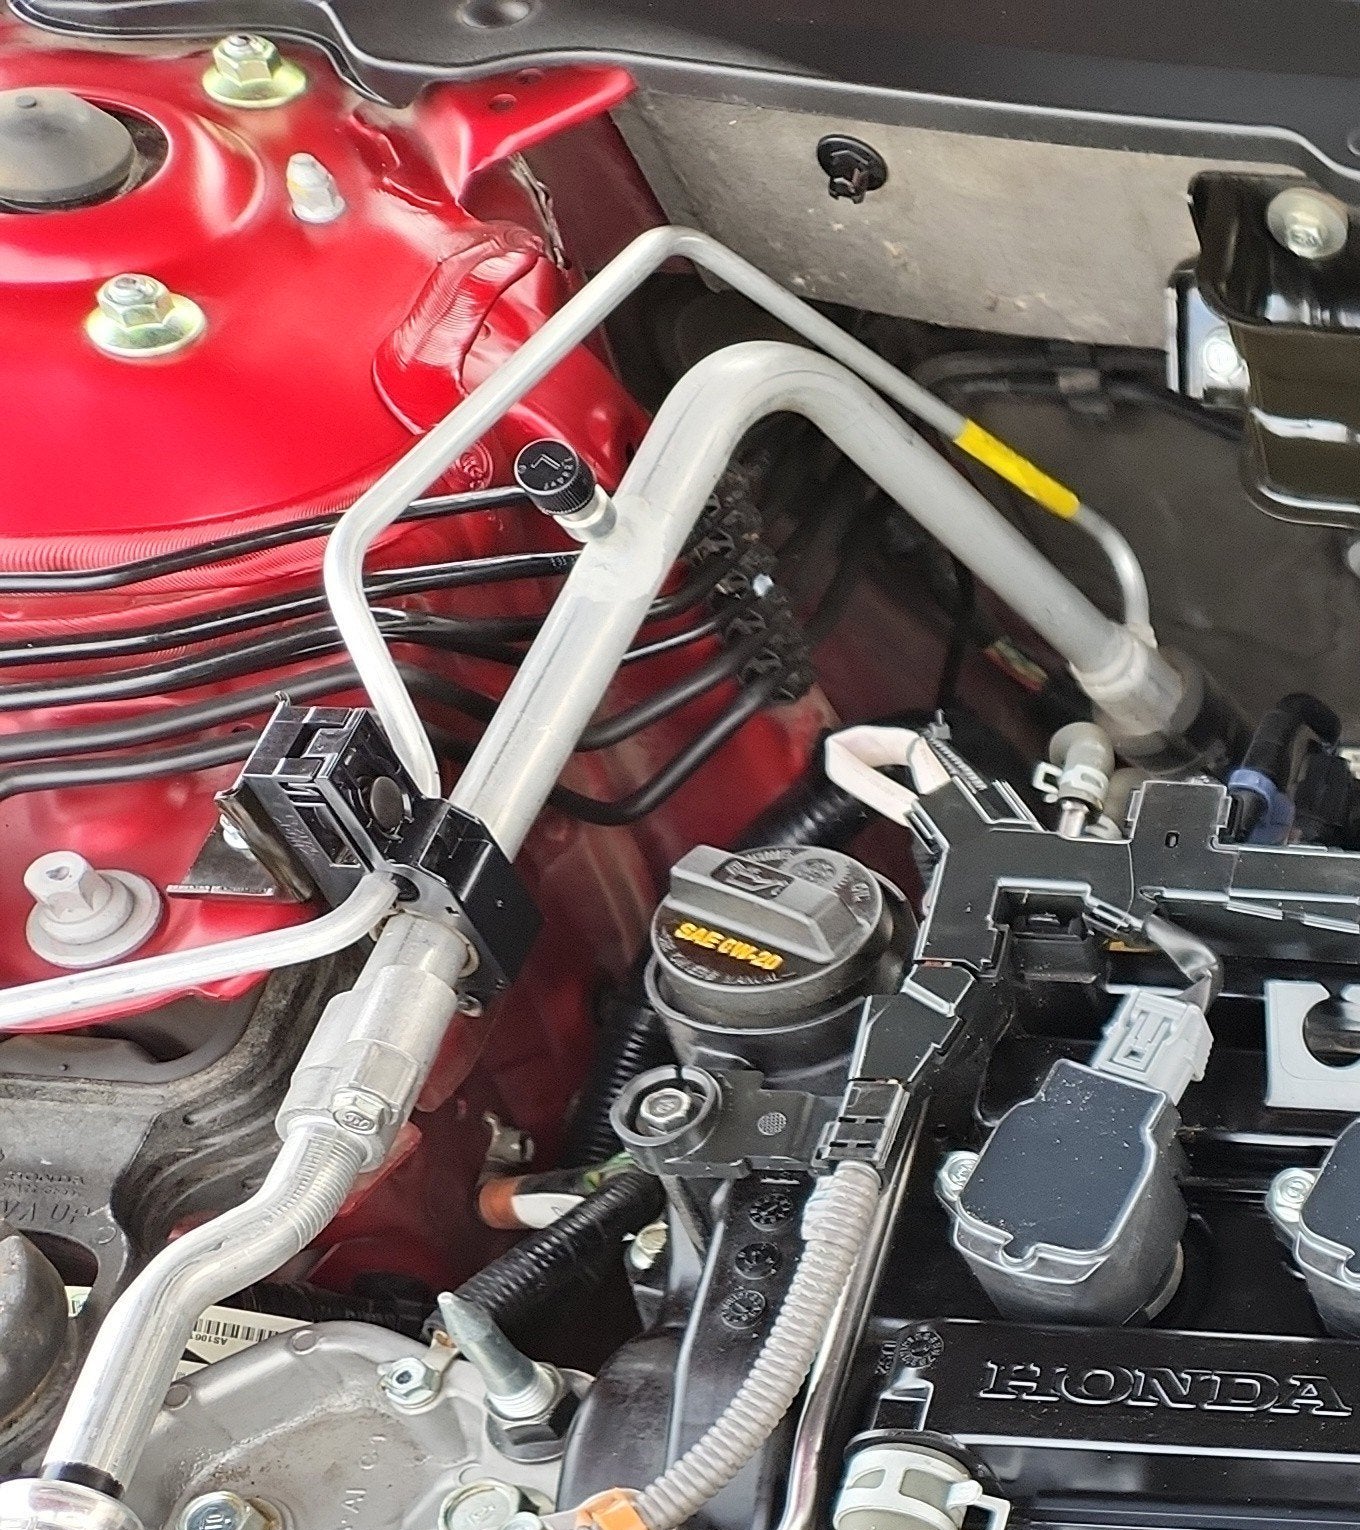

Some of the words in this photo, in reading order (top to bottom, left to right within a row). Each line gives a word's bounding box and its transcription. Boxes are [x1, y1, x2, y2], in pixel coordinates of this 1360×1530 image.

[674, 922, 725, 950] SAE
[189, 1331, 228, 1348] AS106
[979, 1361, 1353, 1416] HONDA
